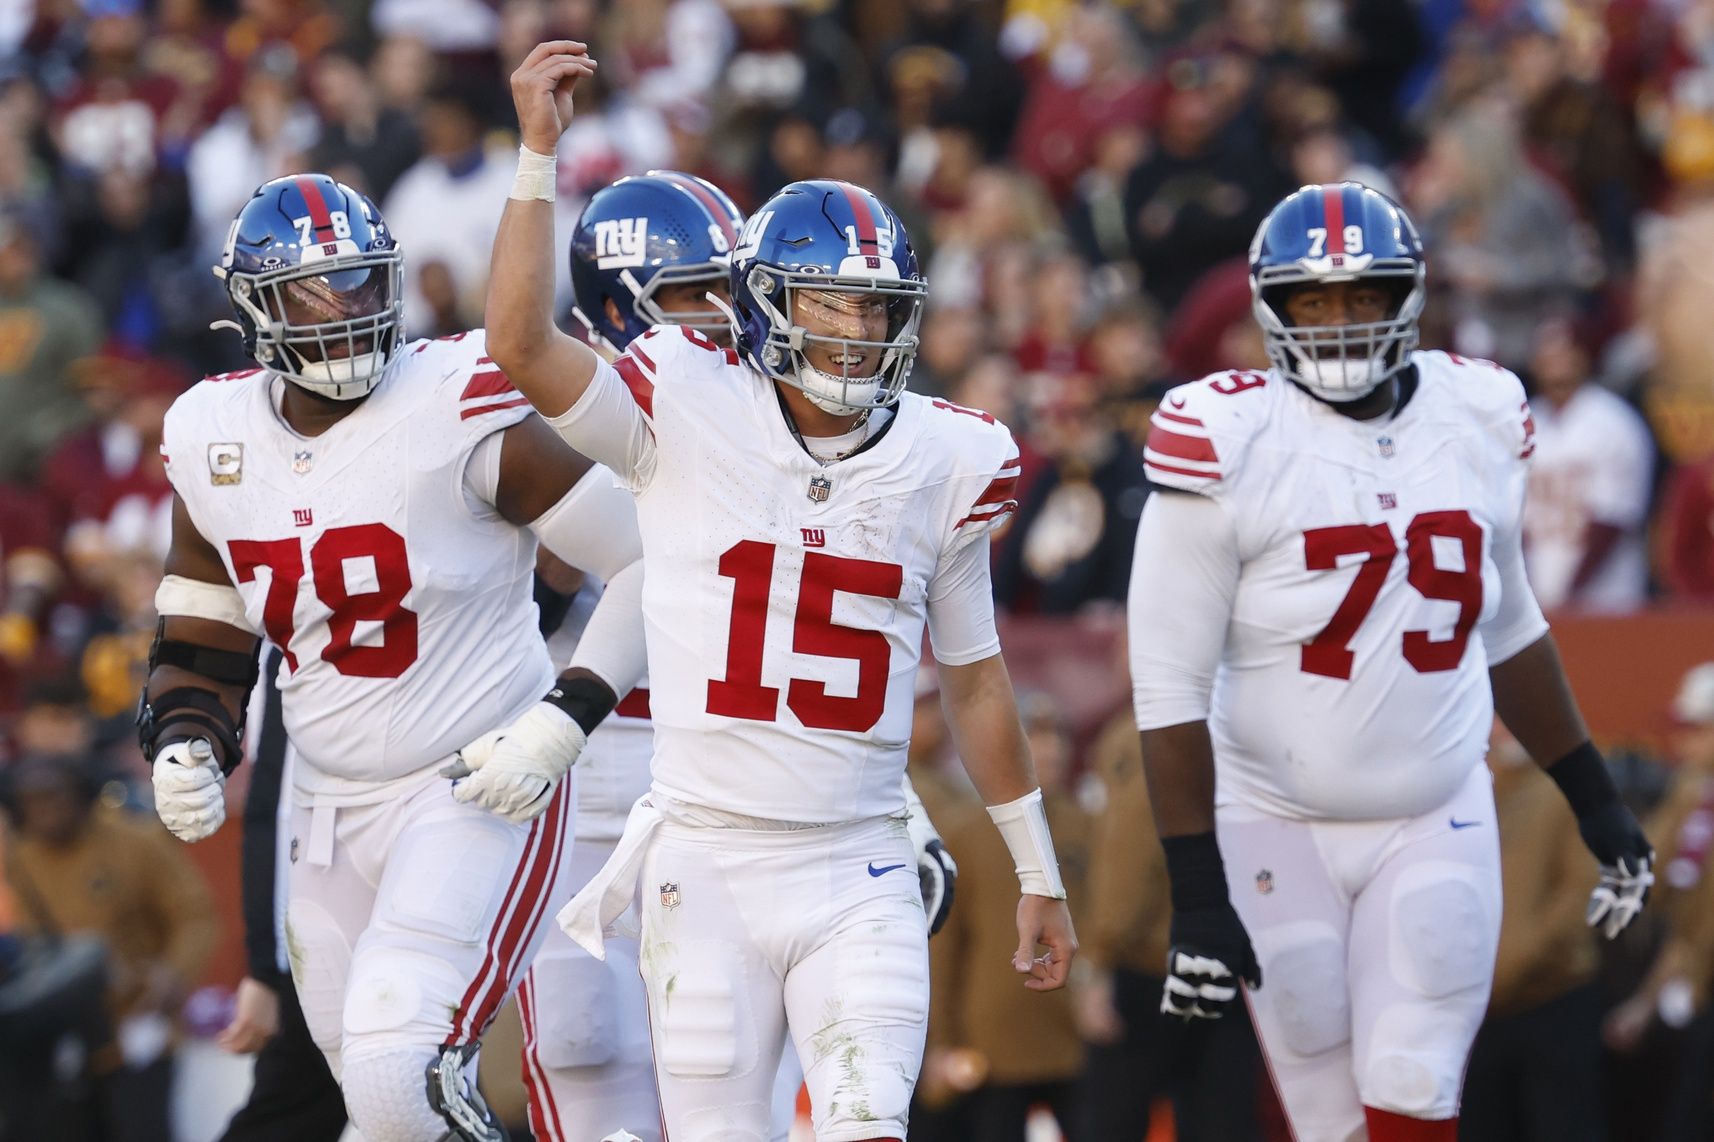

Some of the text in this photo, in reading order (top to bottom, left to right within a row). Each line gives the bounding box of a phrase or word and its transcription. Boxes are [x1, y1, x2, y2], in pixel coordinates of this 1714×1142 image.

[293, 211, 352, 247] 78
[595, 217, 648, 270] ny
[845, 225, 893, 258] 15
[1307, 225, 1363, 257] 79
[210, 445, 241, 475] C
[292, 508, 313, 527] ny
[800, 527, 826, 548] ny
[227, 522, 418, 680] 78
[1301, 510, 1485, 680] 79
[706, 539, 903, 732] 15
